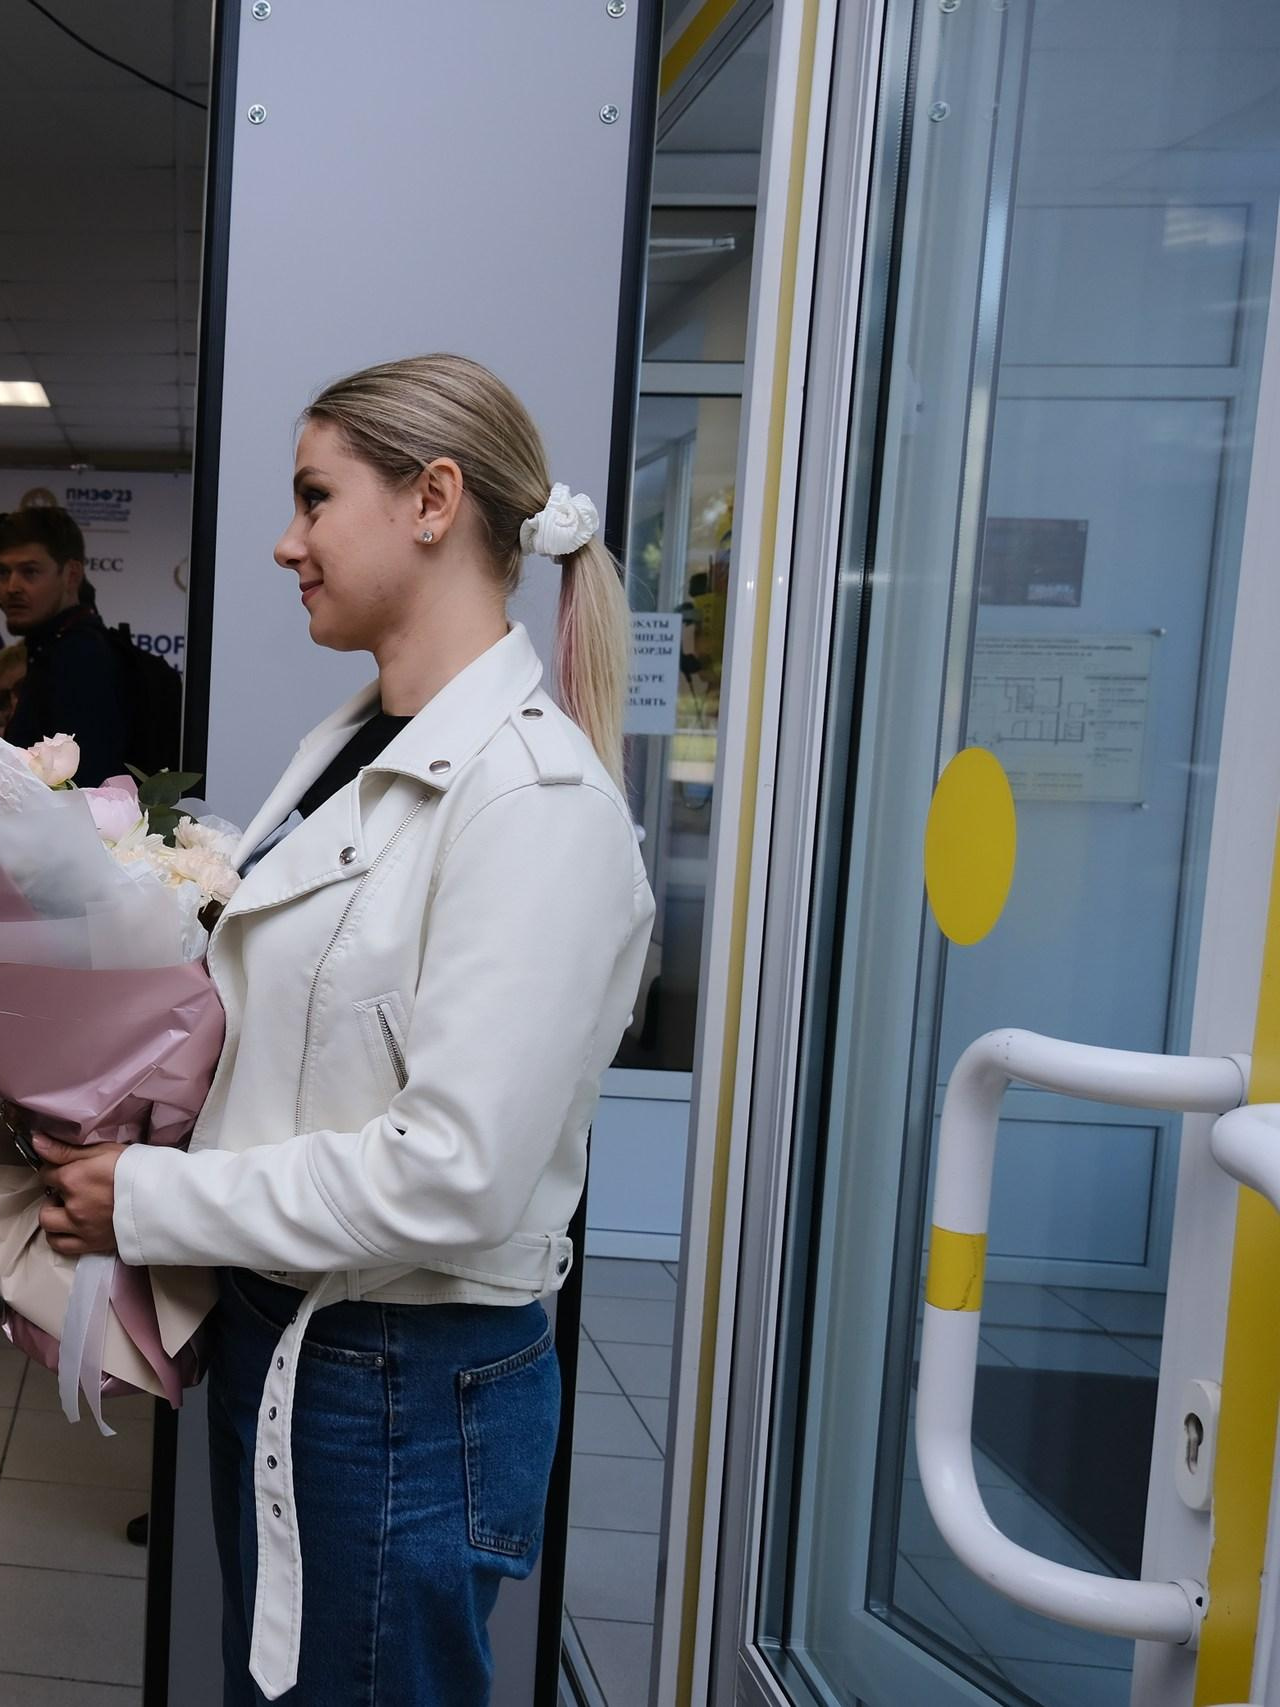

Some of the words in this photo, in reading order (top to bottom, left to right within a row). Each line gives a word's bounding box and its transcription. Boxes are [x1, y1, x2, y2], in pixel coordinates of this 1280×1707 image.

[66, 488, 132, 502] ПМЭФ'23
[129, 634, 184, 654] ВОР
[633, 633, 674, 641] ИПЕДЫ
